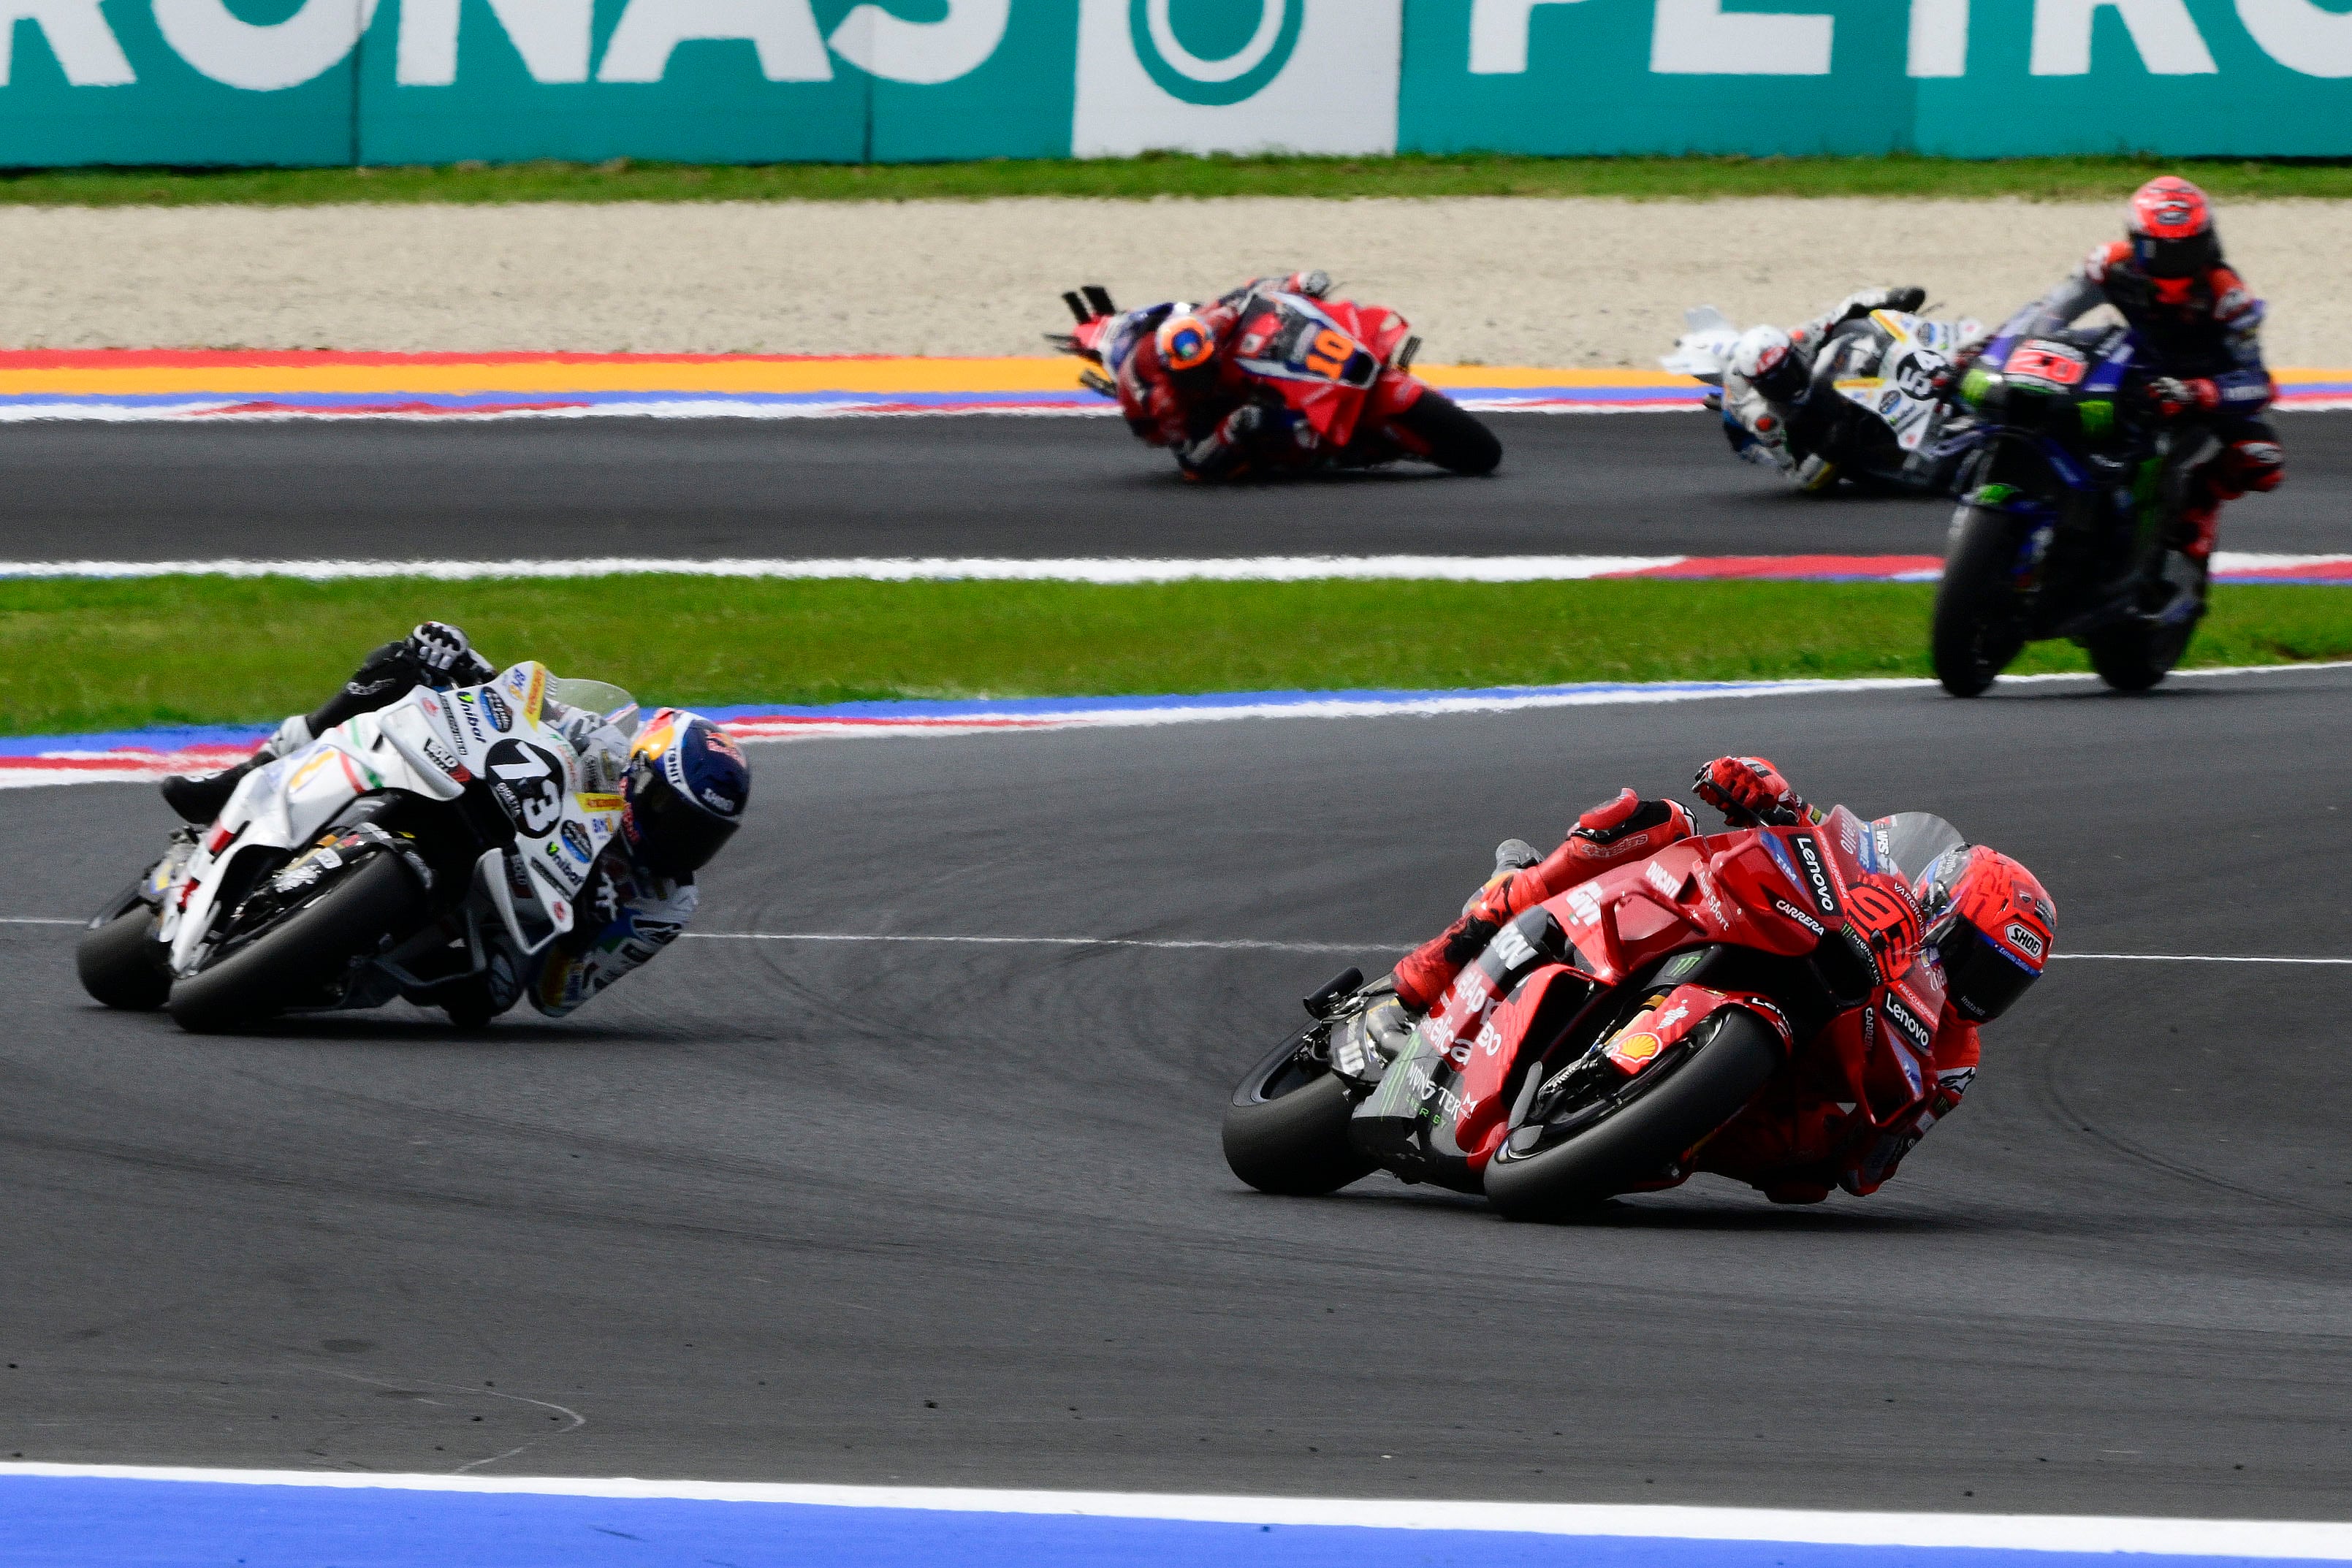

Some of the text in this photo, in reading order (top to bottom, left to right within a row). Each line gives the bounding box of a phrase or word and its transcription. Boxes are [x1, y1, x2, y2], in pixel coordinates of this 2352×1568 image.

[1306, 330, 1355, 381] 10
[1901, 350, 1946, 395] 54
[490, 741, 561, 831] 73
[1776, 853, 1797, 881] TIM
[1876, 830, 1890, 856] WRS
[1645, 861, 1682, 899] DUCATI
[1797, 837, 1834, 912] Lenovo
[1699, 871, 1730, 932] Audi Sport
[1776, 899, 1825, 936] CARRERA
[1849, 885, 1913, 981] 93
[2010, 927, 2041, 956] SHOEI
[1886, 992, 1929, 1046] Lenovo
[1406, 1092, 1447, 1129] ENERGY
[1407, 1062, 1461, 1121] MONSTER
